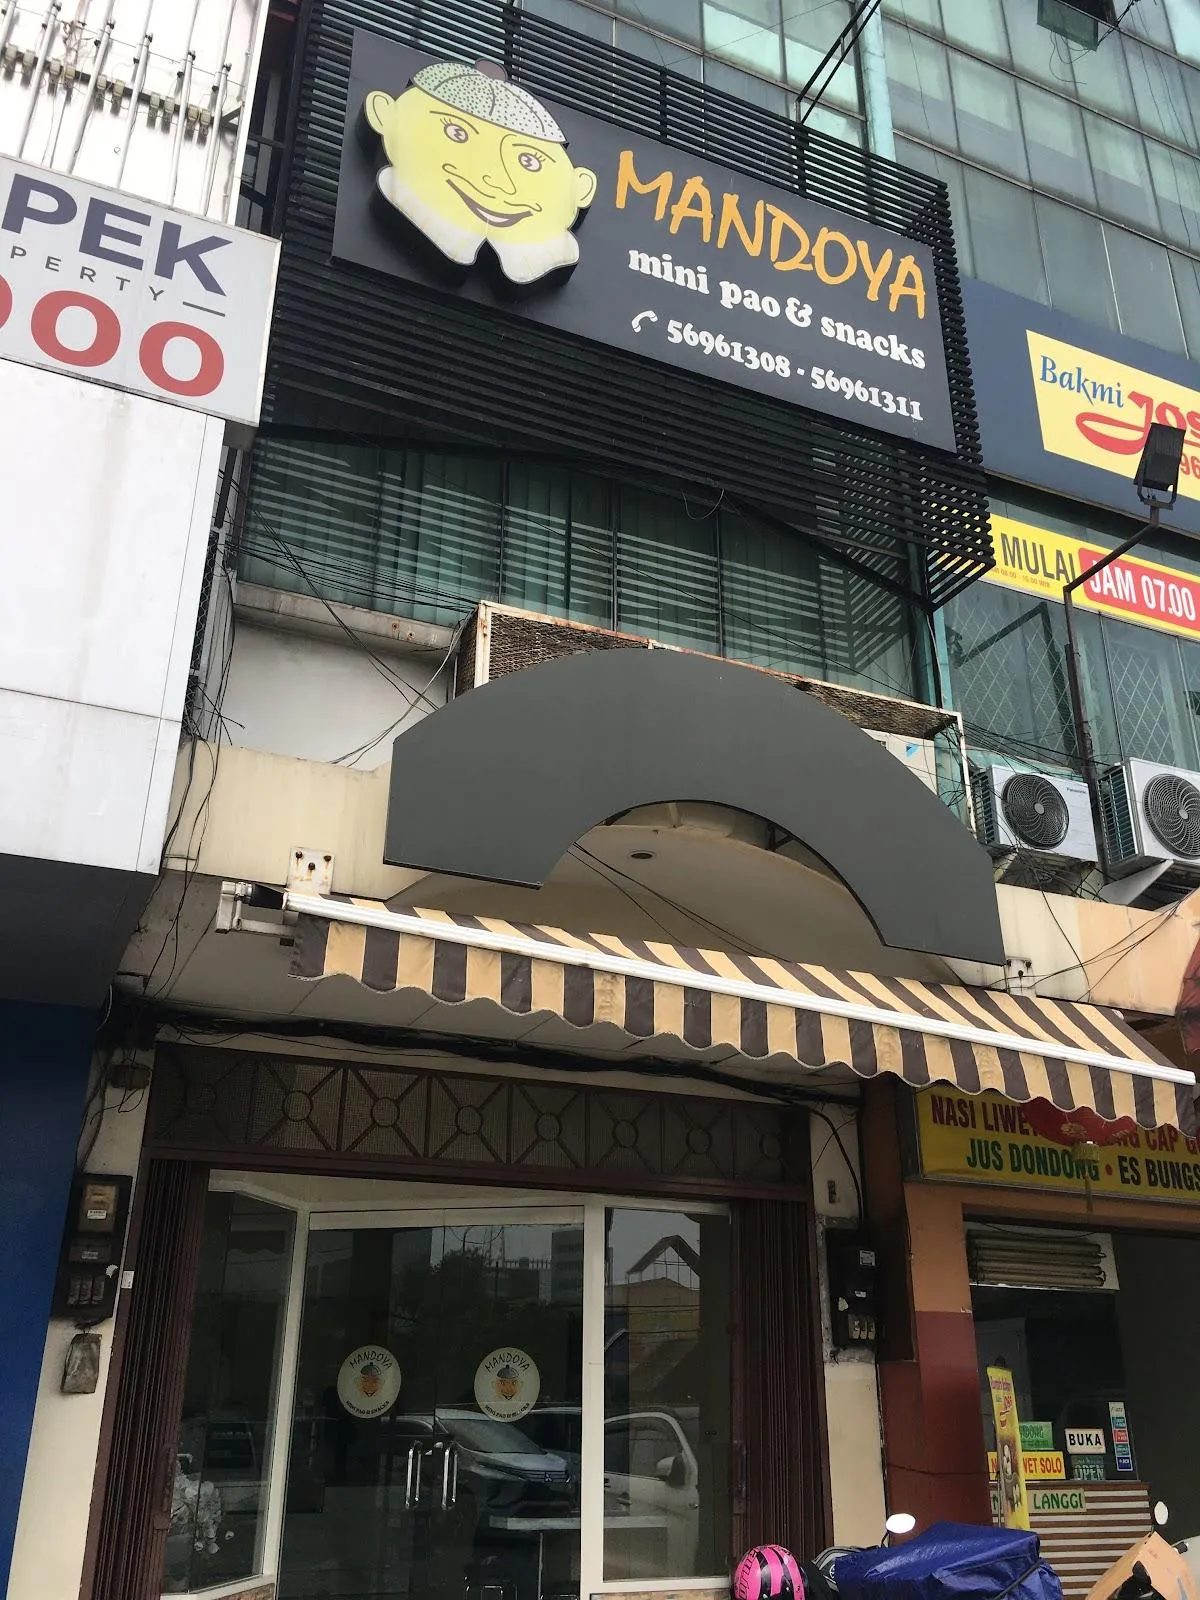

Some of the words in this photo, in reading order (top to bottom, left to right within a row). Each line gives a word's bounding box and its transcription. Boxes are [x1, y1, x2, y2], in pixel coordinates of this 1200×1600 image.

[616, 150, 926, 319] MANDOYA
[628, 249, 710, 294] mini
[719, 280, 781, 318] pao
[785, 296, 813, 328] &
[820, 315, 926, 369] snacks
[666, 319, 791, 378] 56961308
[810, 366, 924, 421] 56961311
[1039, 354, 1124, 407] Bakmi
[1000, 532, 1076, 584] MULAI
[1089, 560, 1137, 604] JAM
[1141, 575, 1196, 621] 07.00
[930, 1095, 977, 1129] NASI
[981, 1101, 1038, 1136] LIWE
[966, 1138, 1004, 1171] JUS
[1117, 1155, 1141, 1185] ES
[349, 1350, 393, 1369] MANDOYA
[484, 1352, 530, 1373] MANDOYA
[1068, 1433, 1102, 1446] BUKA
[1039, 1457, 1062, 1474] SOLO
[1073, 1464, 1105, 1481] OPEN
[1033, 1493, 1084, 1510] LANGGI
